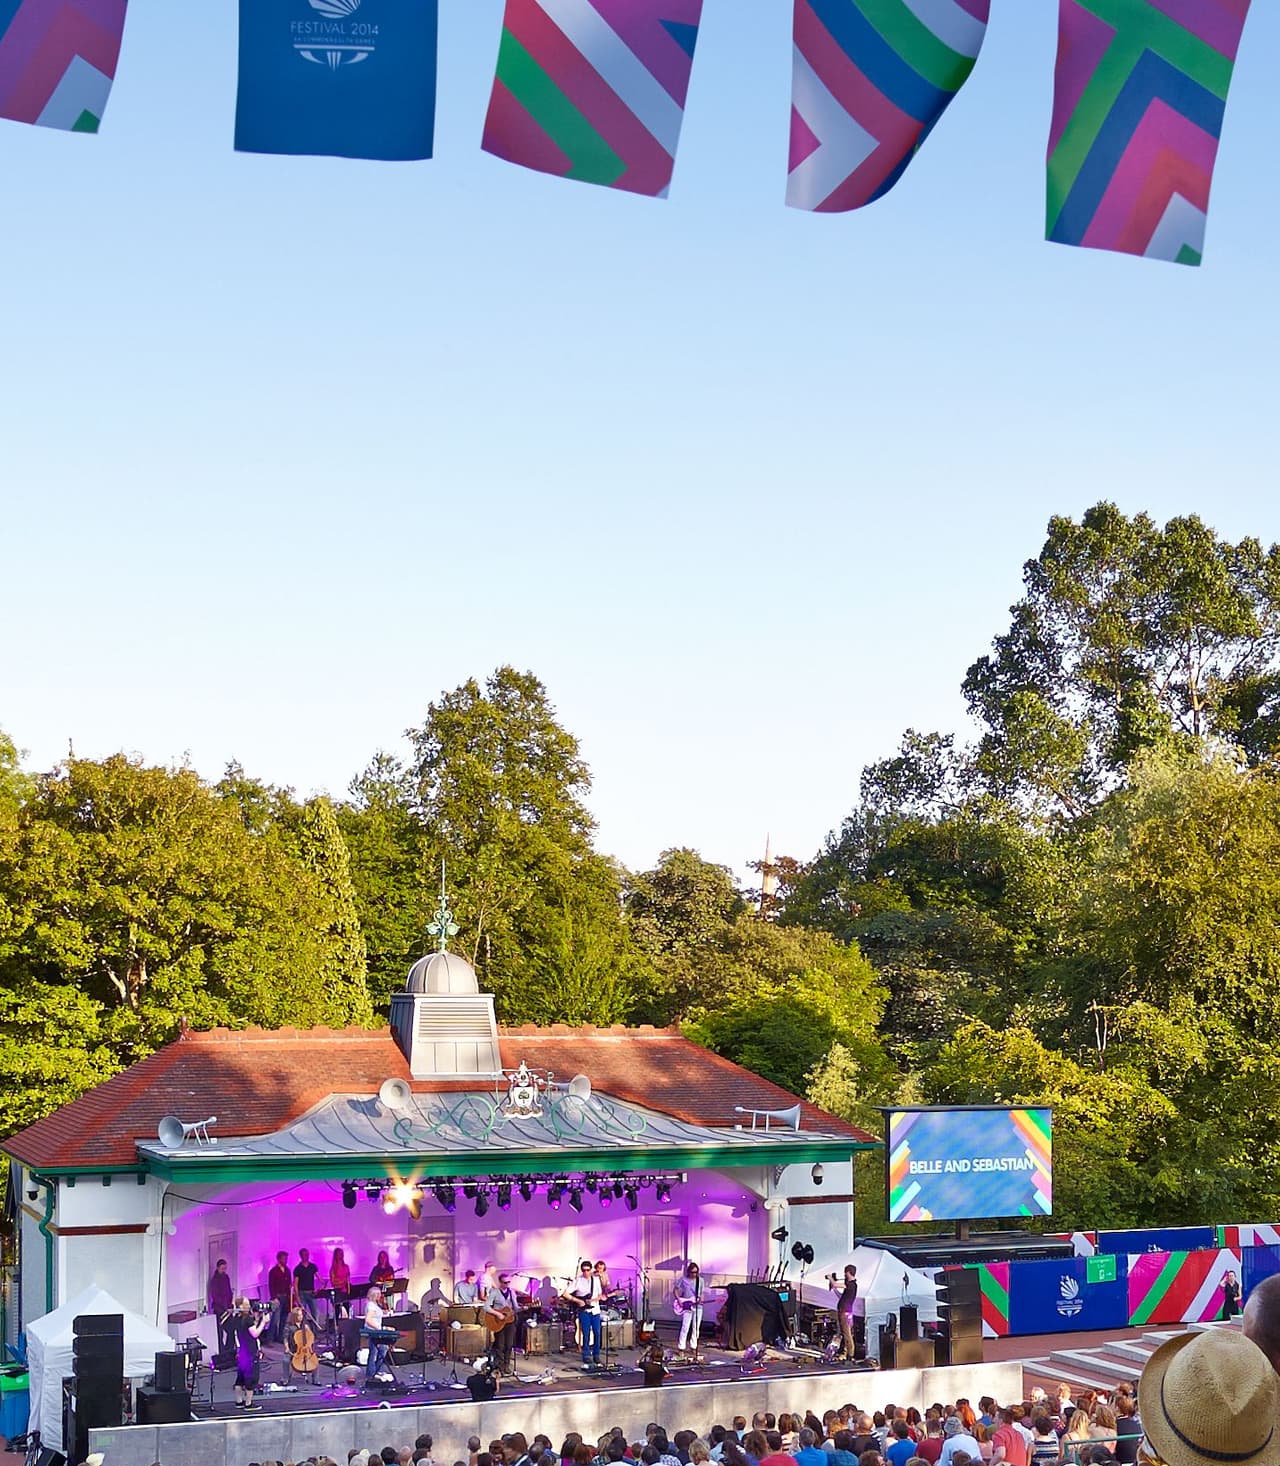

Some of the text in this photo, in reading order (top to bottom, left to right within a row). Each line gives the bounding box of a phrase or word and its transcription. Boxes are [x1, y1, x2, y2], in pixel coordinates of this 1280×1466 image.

[290, 21, 379, 36] FESTIVAL 2014
[909, 1157, 1034, 1174] BELLE AND SEBASTIAN
